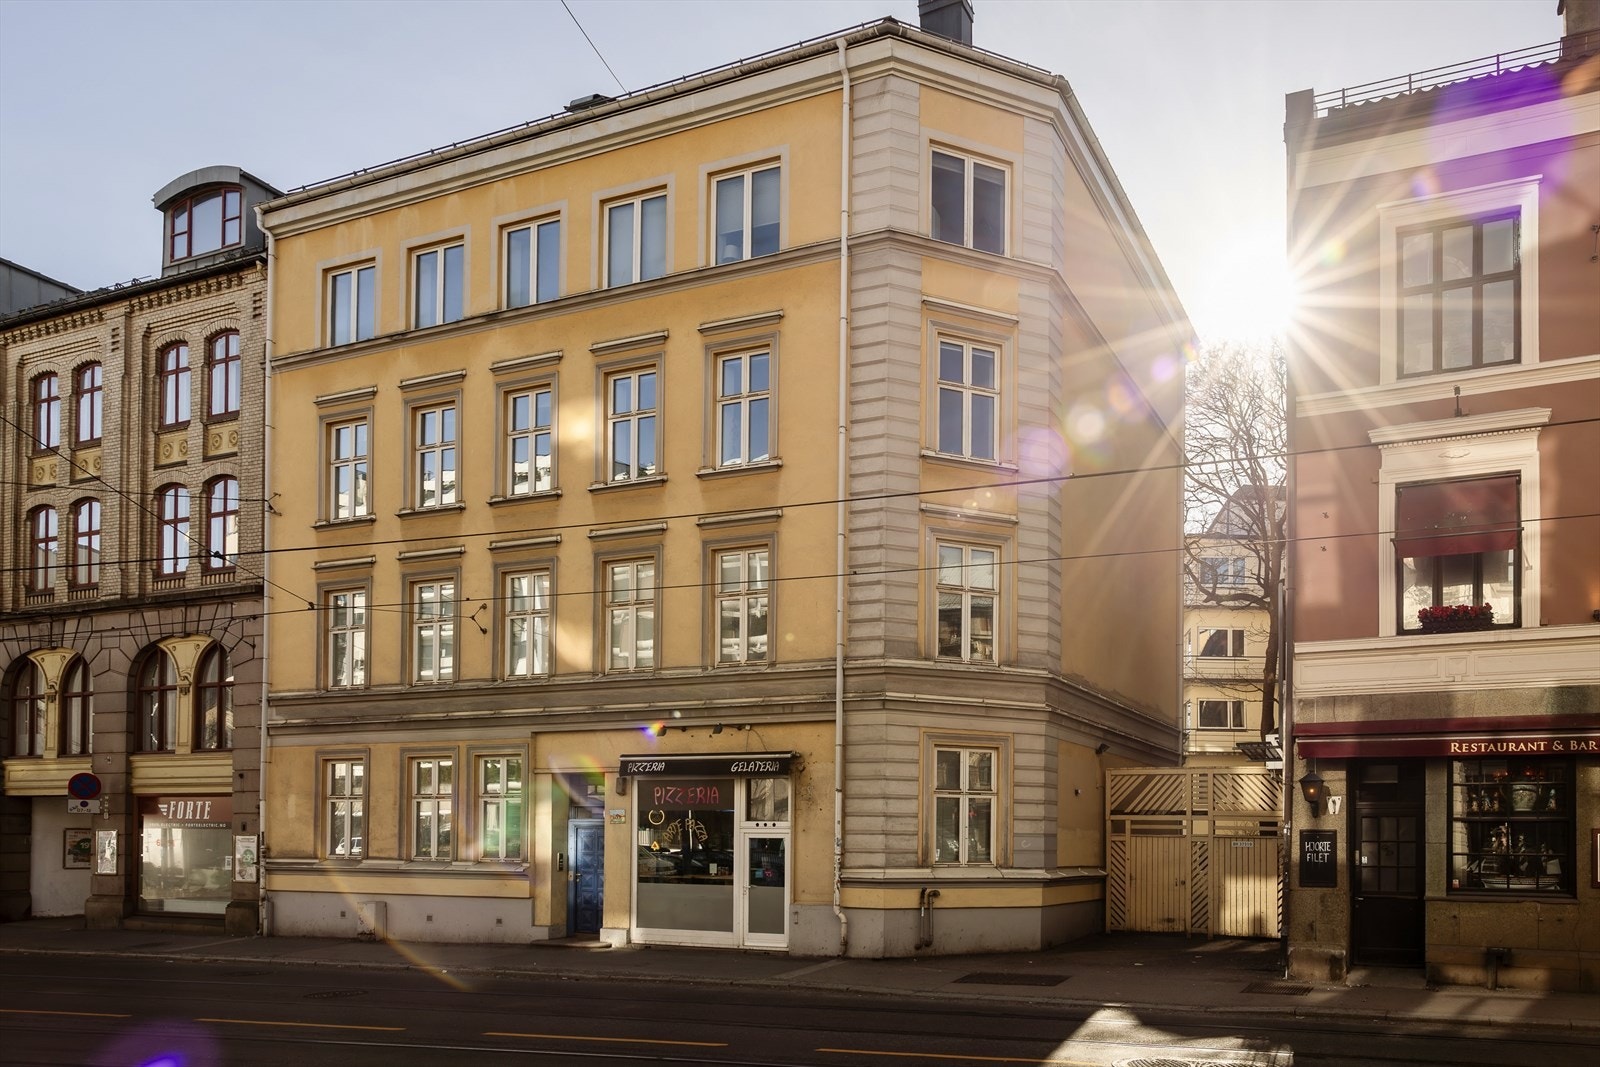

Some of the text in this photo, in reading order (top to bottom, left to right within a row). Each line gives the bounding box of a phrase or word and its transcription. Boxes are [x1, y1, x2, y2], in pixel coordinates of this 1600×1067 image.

[1450, 740, 1598, 753] RESTAURANT & BAR
[628, 762, 666, 773] PIZZERIA
[731, 761, 780, 772] GELATERIA
[654, 786, 720, 805] PIZZERIA
[168, 801, 212, 819] FORTE
[1305, 841, 1332, 852] HJORTE
[1306, 853, 1330, 863] FILET
